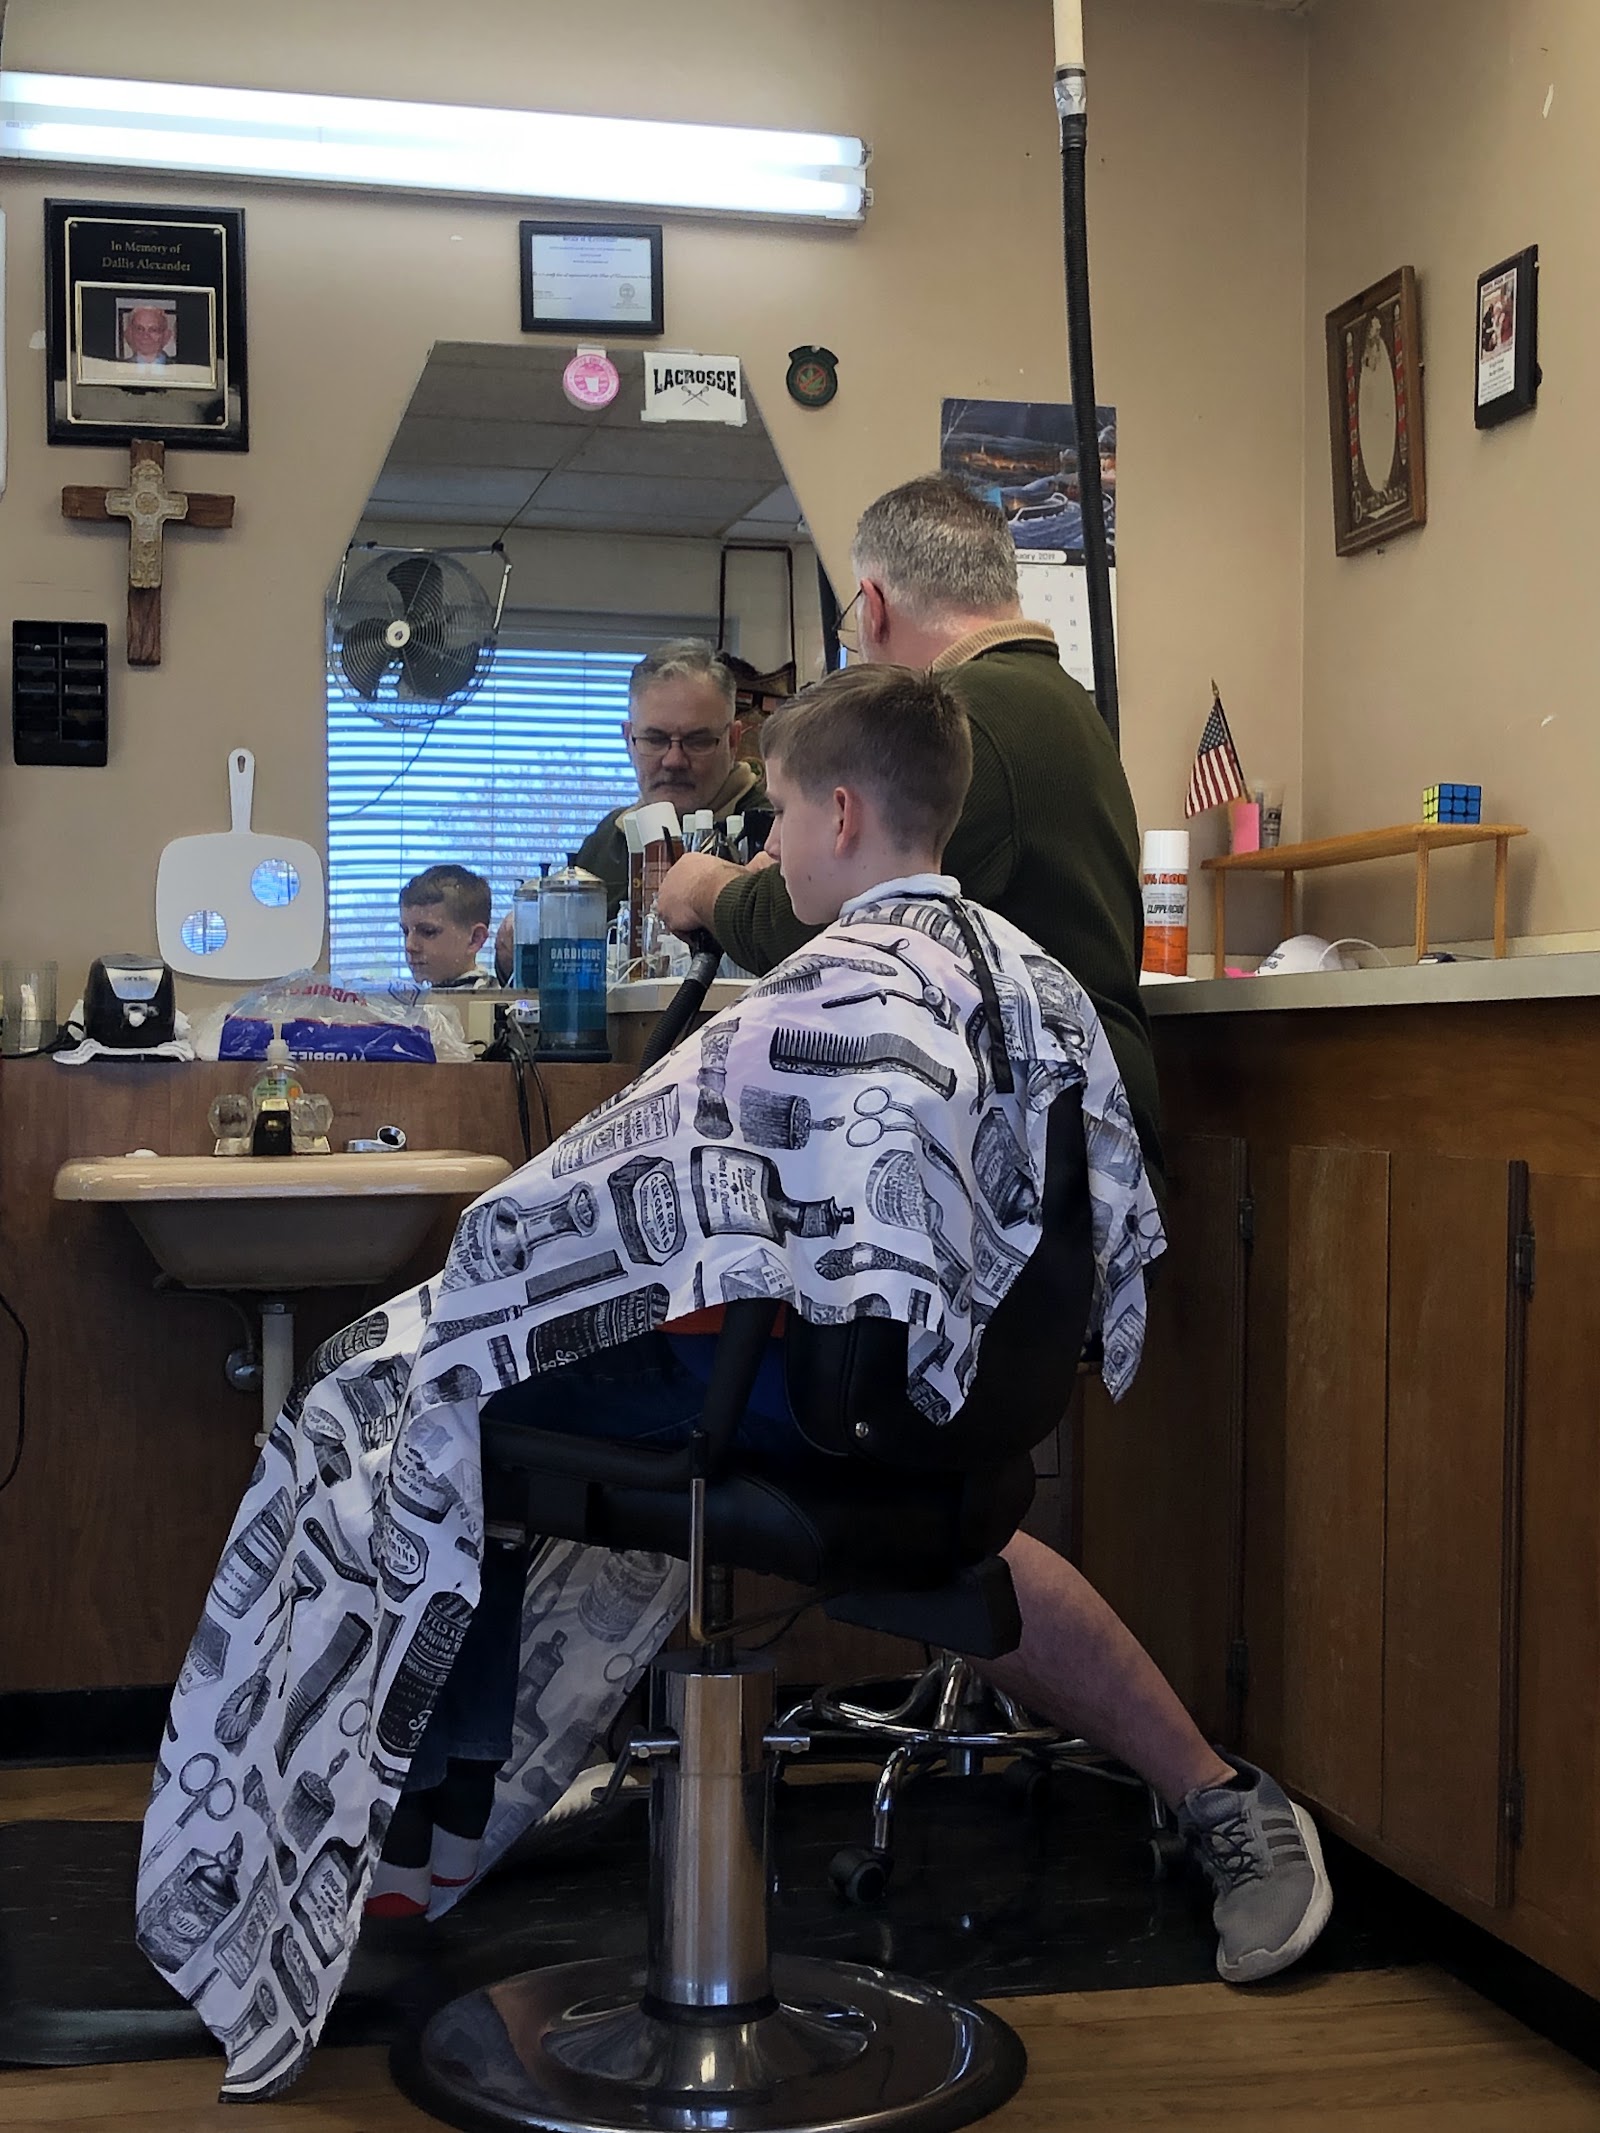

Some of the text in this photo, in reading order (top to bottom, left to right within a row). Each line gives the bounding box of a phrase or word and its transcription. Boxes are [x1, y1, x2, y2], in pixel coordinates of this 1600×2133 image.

[111, 240, 183, 255] In Memory of
[136, 259, 191, 272] Alexander
[653, 368, 737, 397] LACROSSE
[659, 1178, 671, 1199] FELS
[649, 1176, 671, 1249] GLYCERINE
[424, 1612, 449, 1635] FELS
[417, 1621, 453, 1650] SHAVING
[402, 1656, 435, 1680] SHAVING
